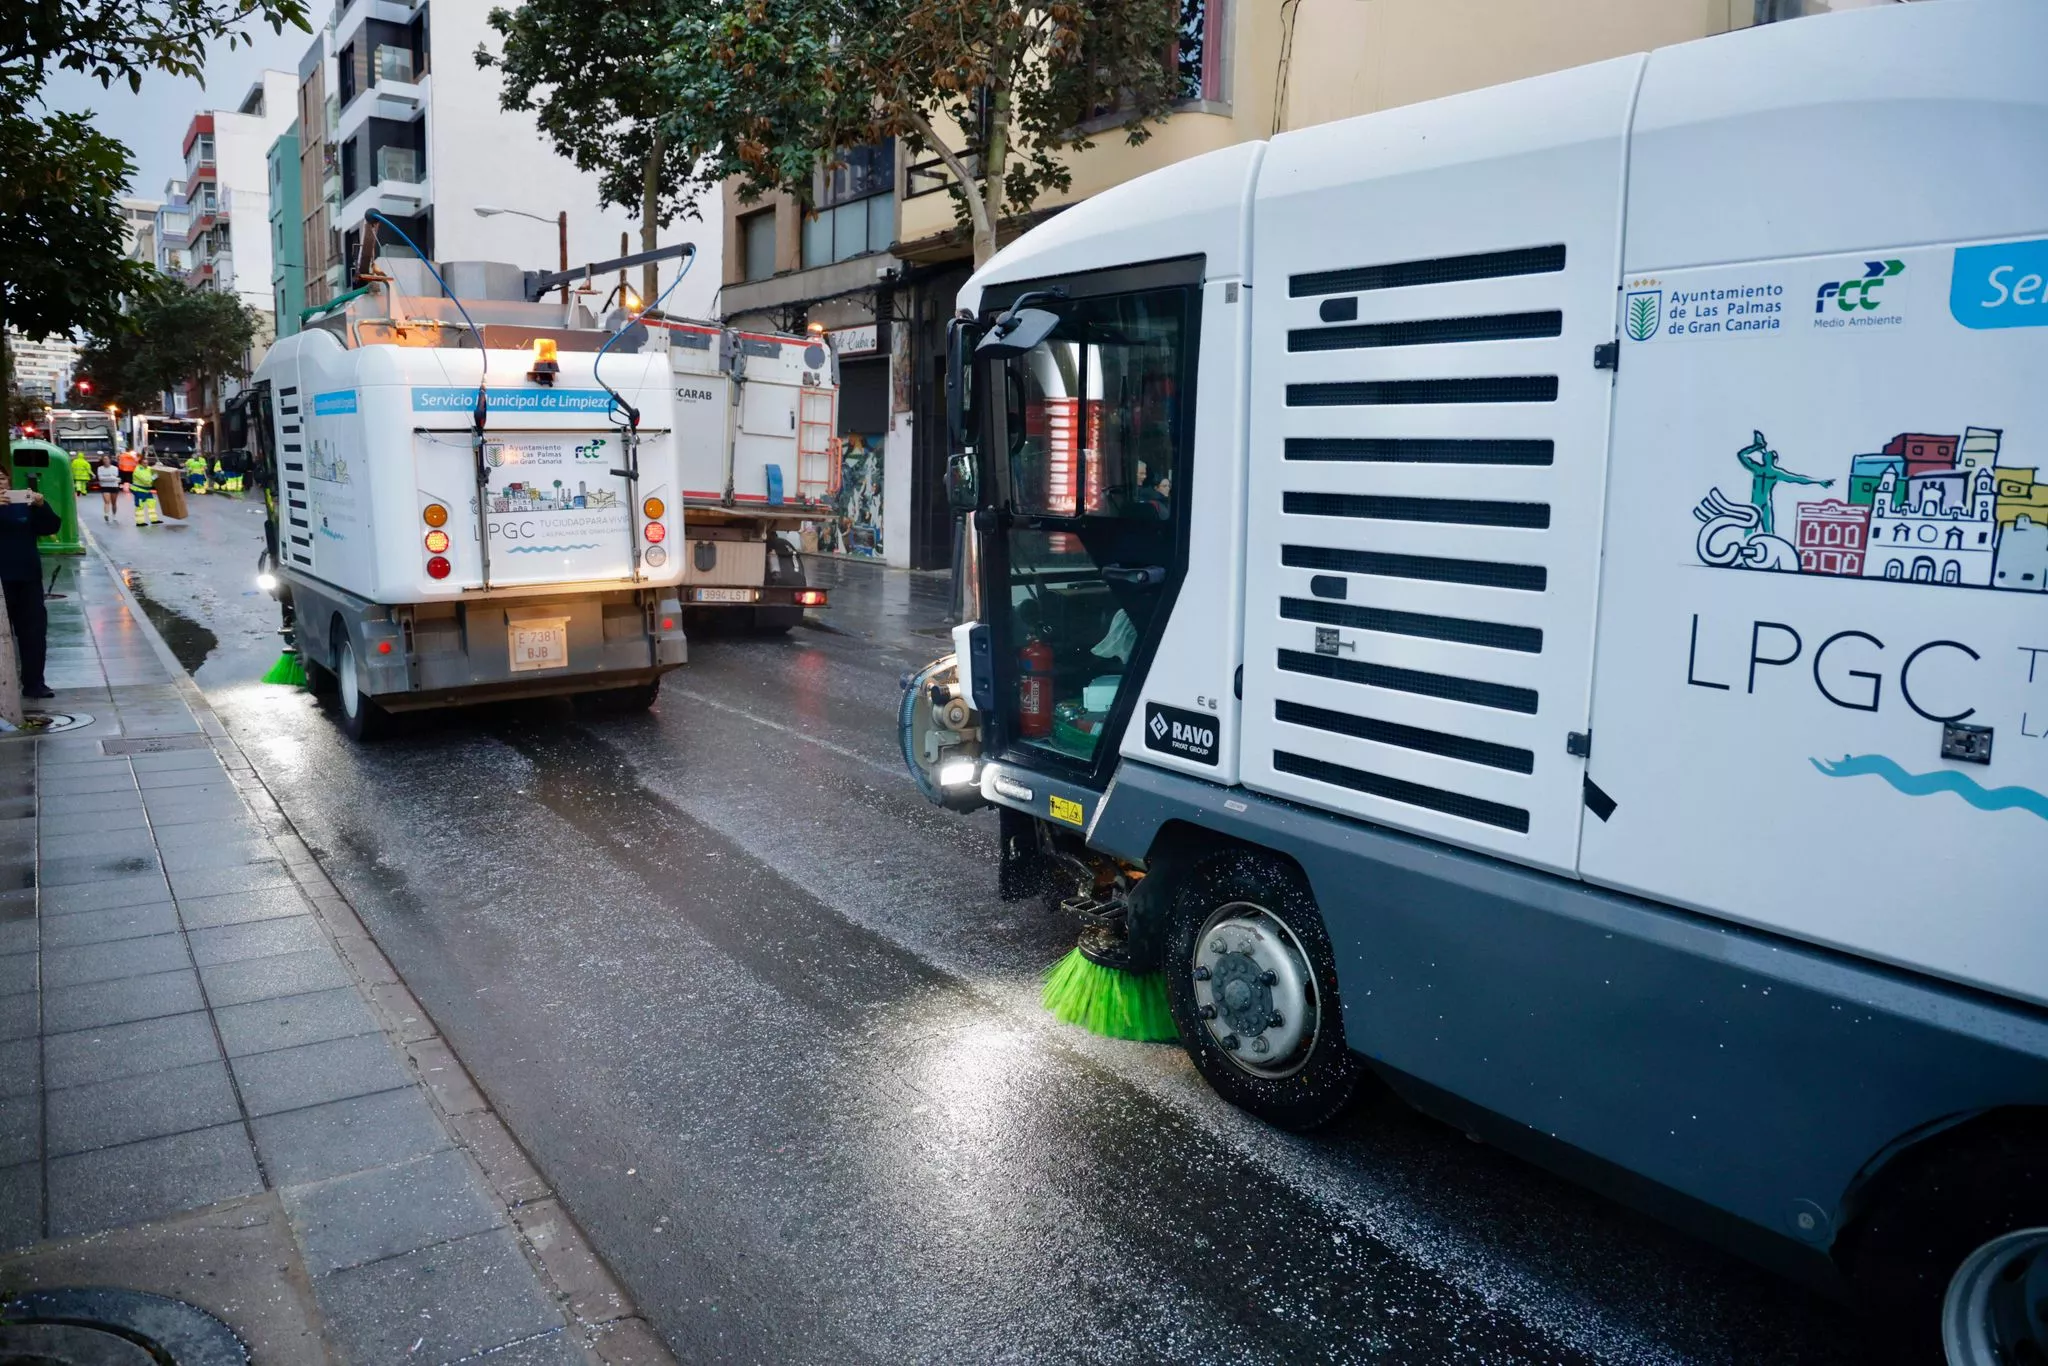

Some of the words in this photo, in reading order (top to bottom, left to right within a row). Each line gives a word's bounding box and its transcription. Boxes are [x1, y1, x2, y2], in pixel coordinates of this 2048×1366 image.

[1670, 284, 1784, 305] Ayuntamiento
[1815, 278, 1885, 314] FCC
[1669, 305, 1687, 320] de
[1695, 303, 1719, 318] Las
[1727, 300, 1782, 315] Palmas
[1668, 321, 1685, 335] de
[1688, 318, 1721, 334] Gran
[1725, 316, 1781, 332] Canaria
[1813, 315, 1846, 329] Medio
[1848, 314, 1904, 327] Ambiente
[420, 392, 473, 407] Servicio
[541, 394, 556, 407] de
[674, 387, 713, 401] CARAB
[509, 444, 562, 452] Ayuntamiento
[574, 445, 601, 459] FCC
[540, 519, 552, 528] TU
[552, 517, 585, 528] CIUDAD
[585, 516, 607, 526] PARA
[729, 590, 747, 601] LST
[530, 630, 557, 642] 7381
[1687, 613, 1981, 723] LPGC
[1171, 721, 1214, 748] RAVO
[1171, 740, 1189, 751] FAYAT
[1188, 743, 1209, 756] GROUP
